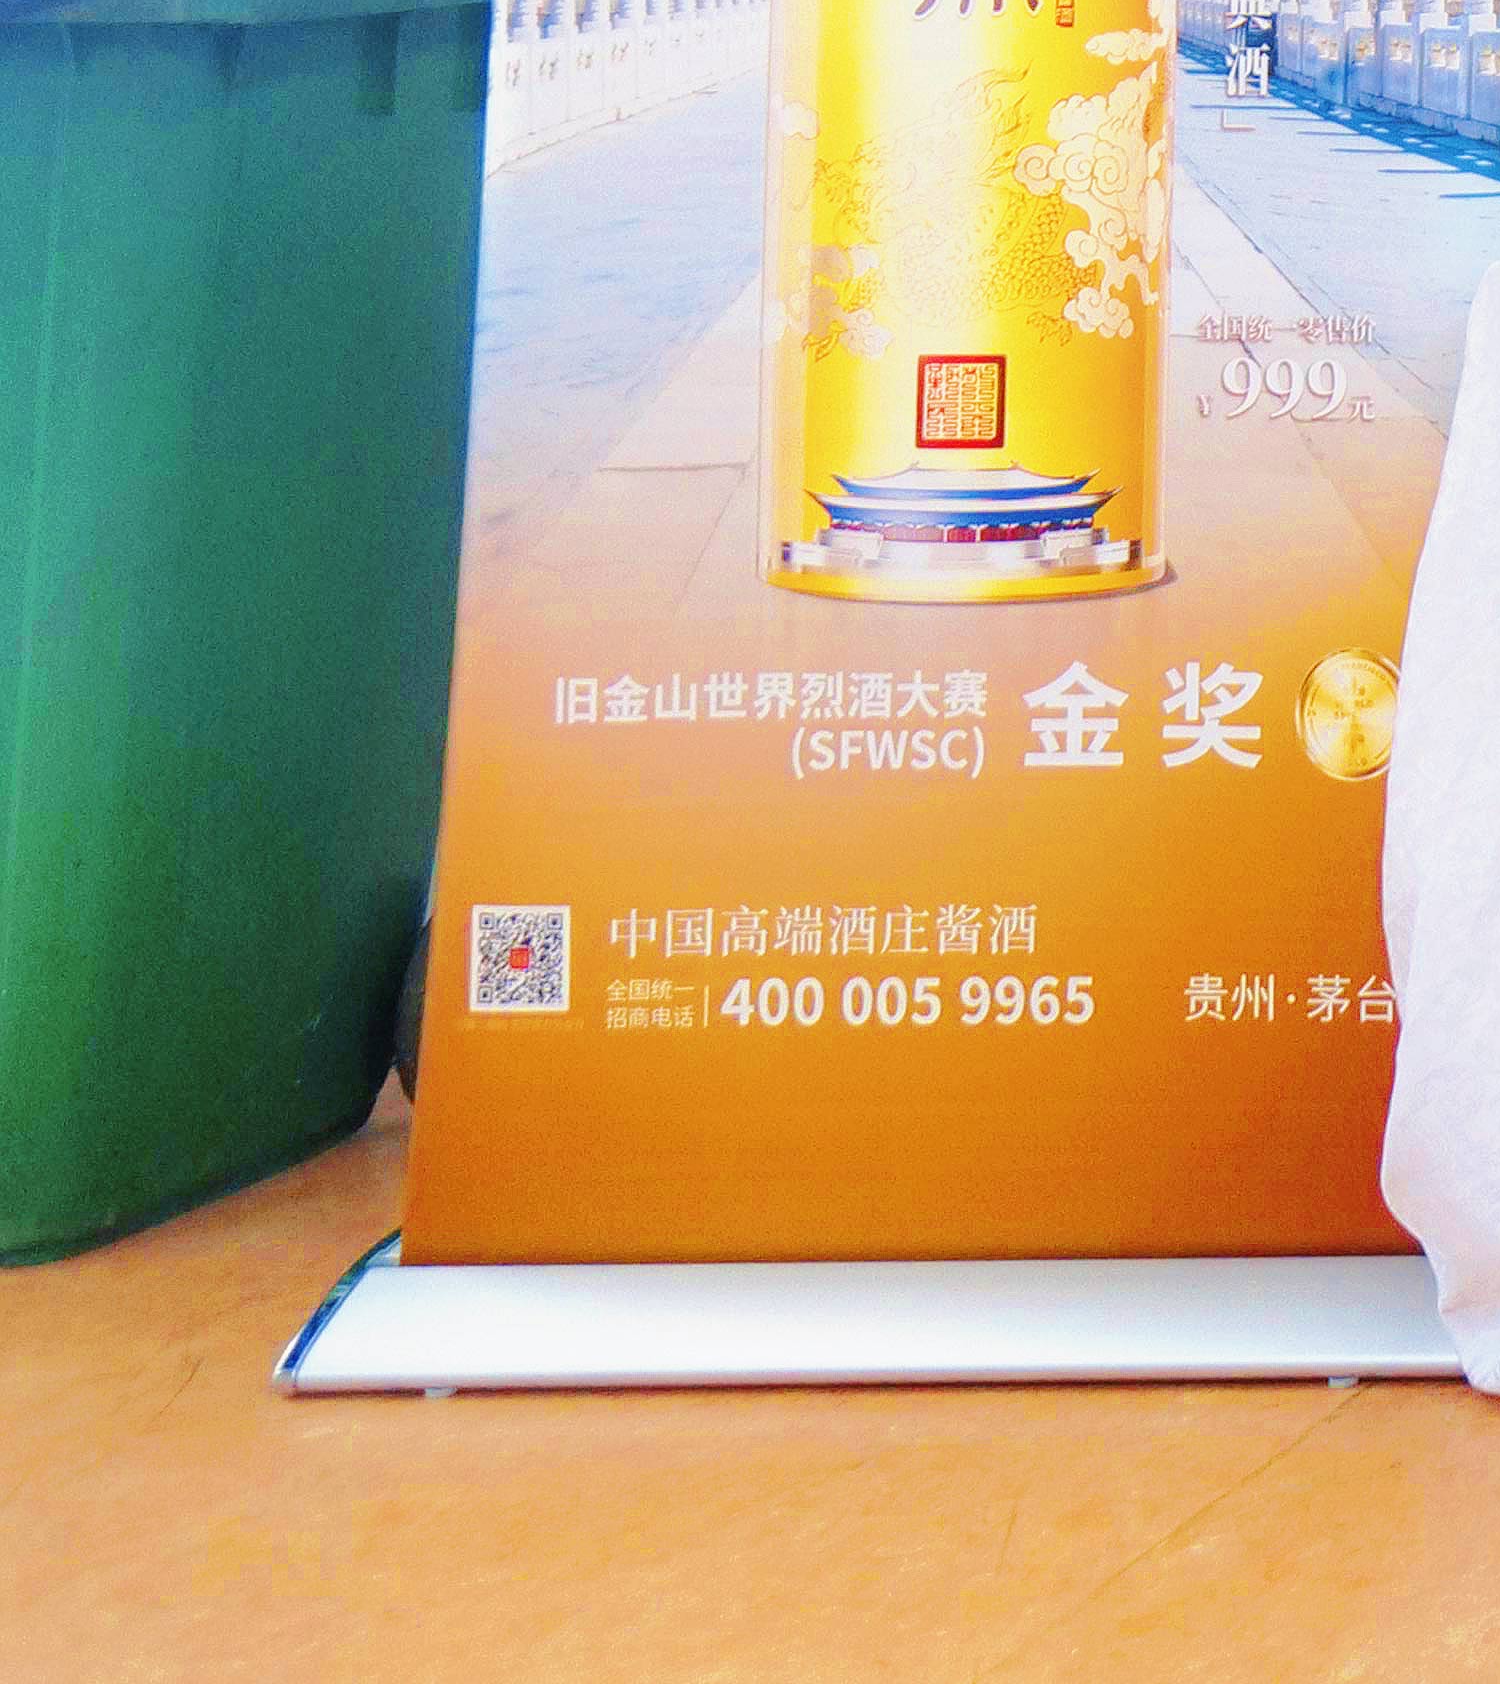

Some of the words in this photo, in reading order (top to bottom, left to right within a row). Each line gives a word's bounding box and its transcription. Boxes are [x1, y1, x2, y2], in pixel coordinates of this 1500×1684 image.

[1197, 313, 1377, 344] 全国统一零售价
[555, 671, 988, 725] 旧金山世界烈酒大赛
[792, 726, 985, 779] (SFWSC)
[608, 903, 1039, 960] 中国高端酒庄酱酒
[606, 978, 696, 1002] 全国统一
[606, 1004, 695, 1029] 招商电话
[719, 975, 824, 1027] 400
[841, 974, 942, 1026] 005
[960, 973, 1096, 1025] 9965
